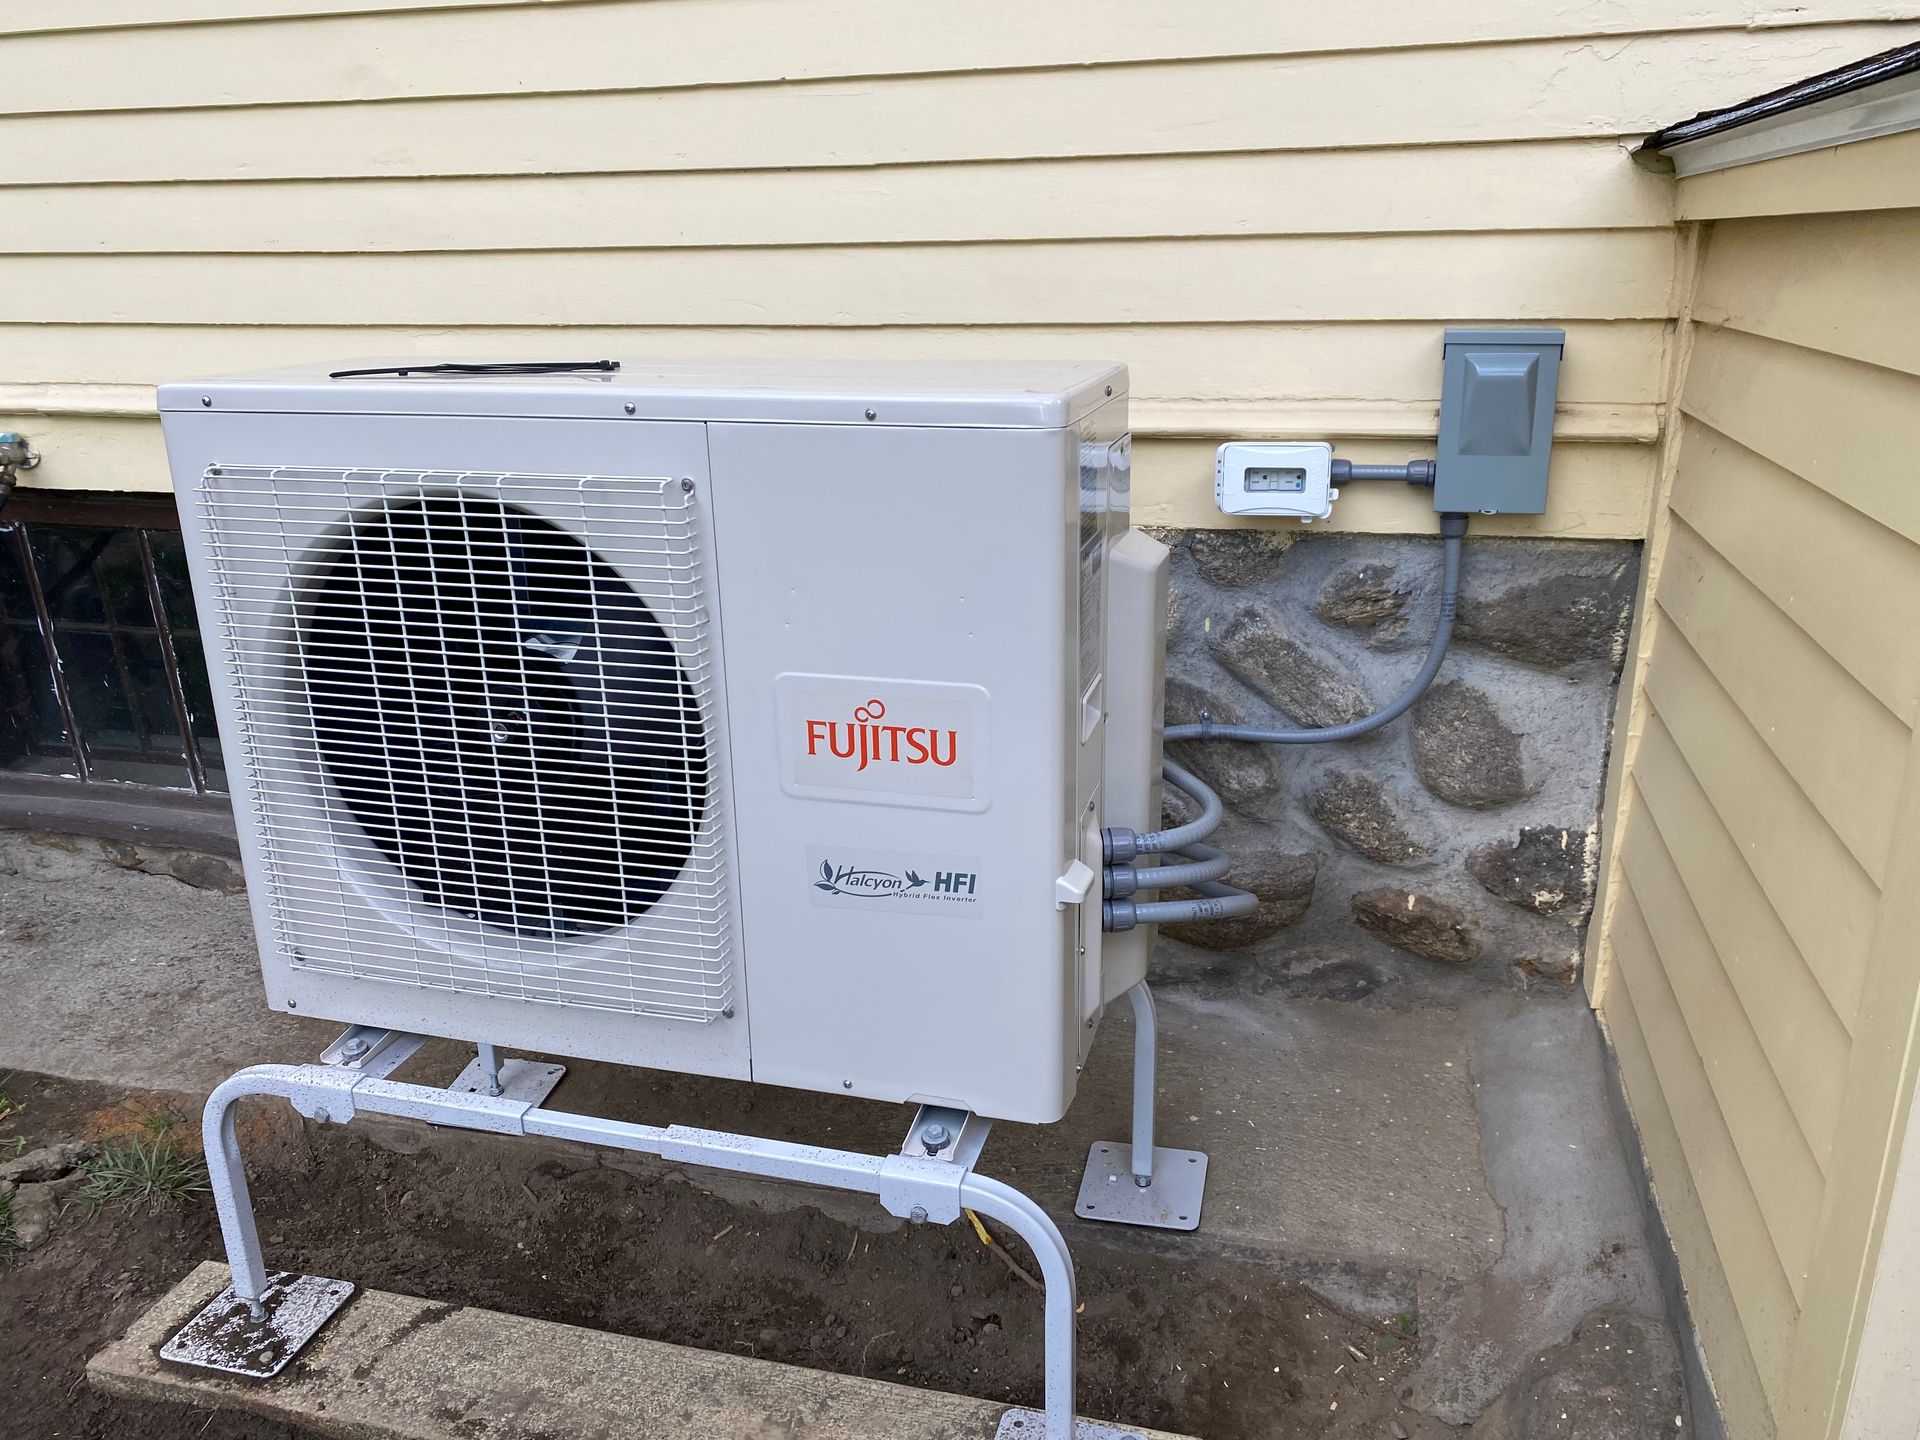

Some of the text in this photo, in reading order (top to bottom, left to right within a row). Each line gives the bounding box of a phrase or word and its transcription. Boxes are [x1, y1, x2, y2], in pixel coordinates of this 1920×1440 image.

[806, 700, 957, 772] FUJITSU
[834, 865, 977, 895] Halcyon HFI
[892, 891, 977, 903] Hybrid Flex Inverter
